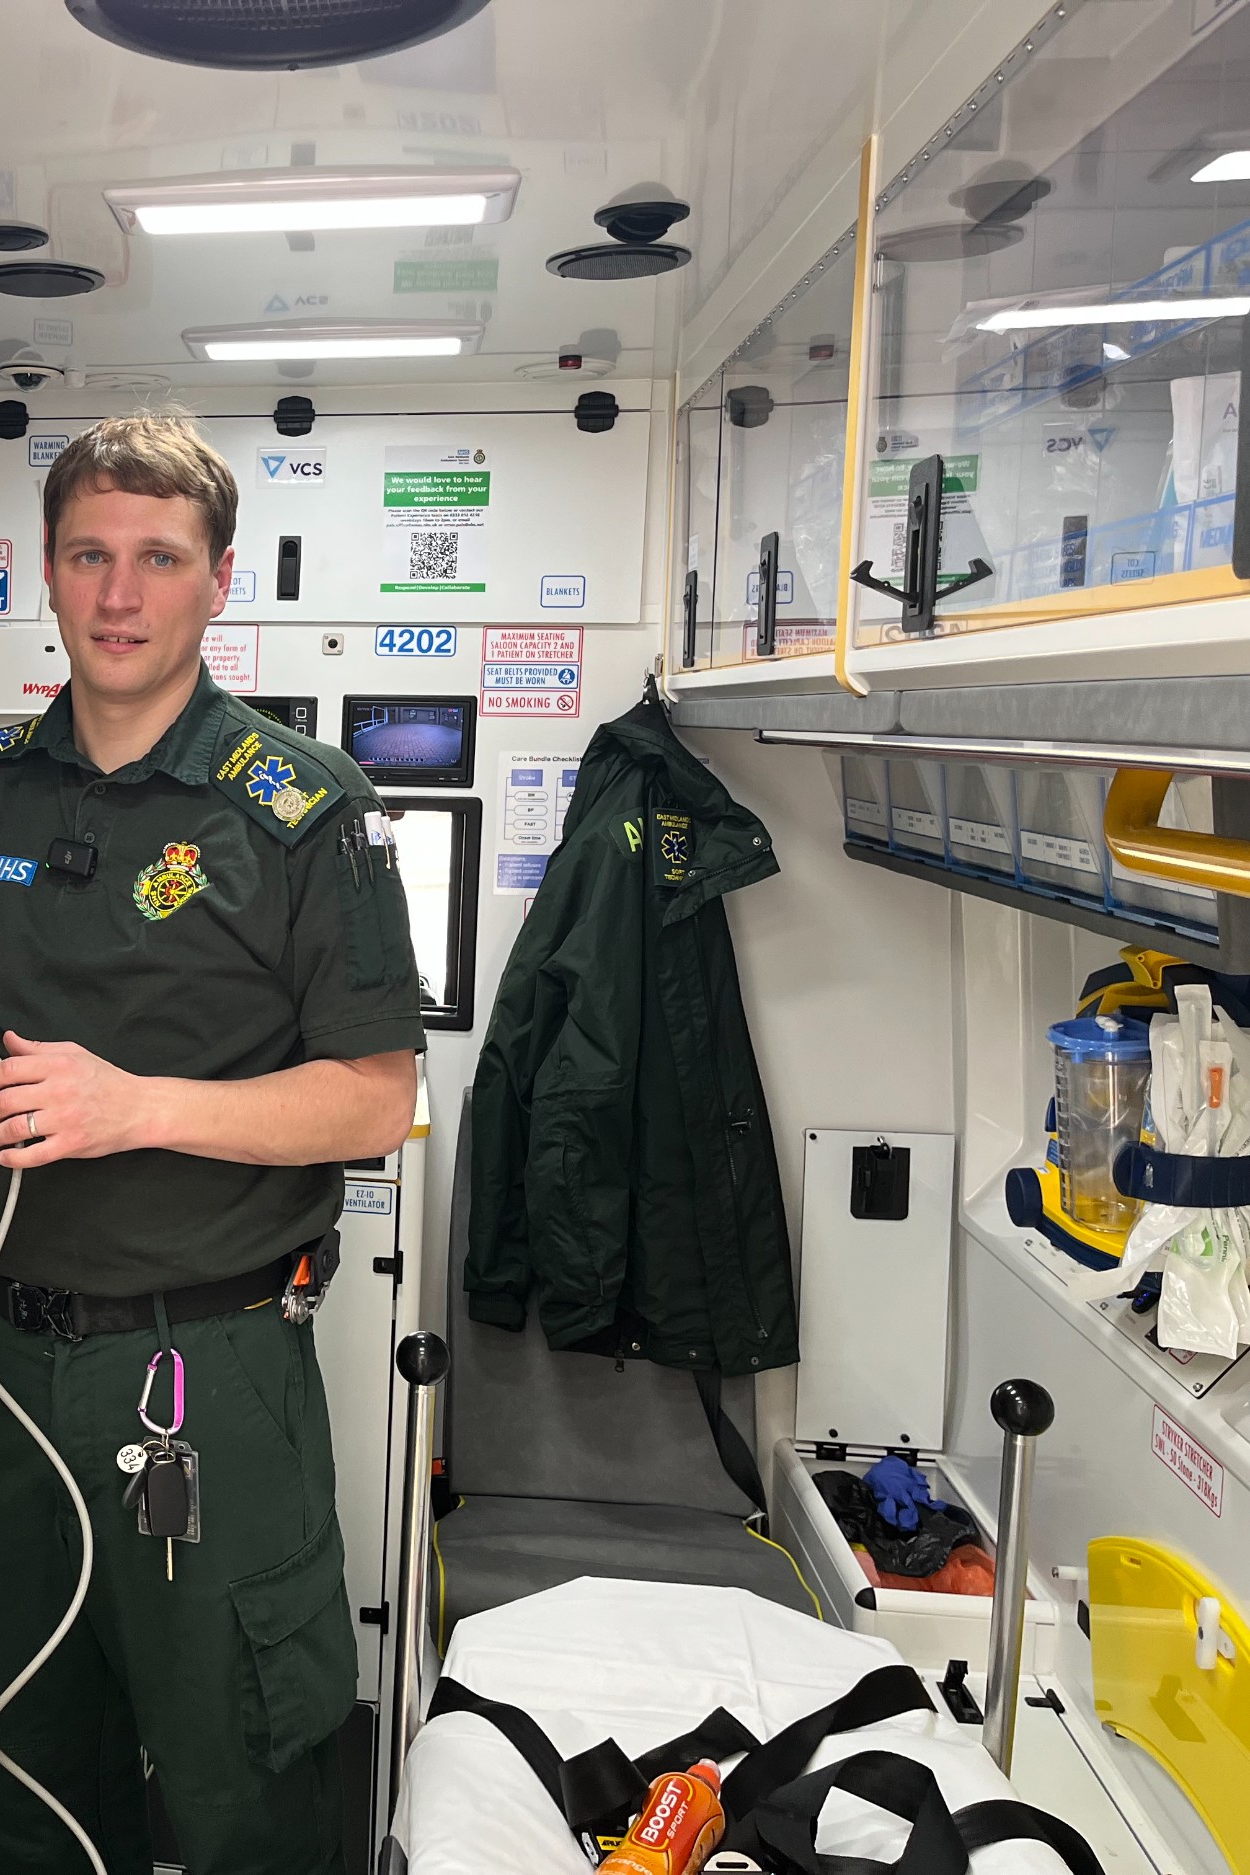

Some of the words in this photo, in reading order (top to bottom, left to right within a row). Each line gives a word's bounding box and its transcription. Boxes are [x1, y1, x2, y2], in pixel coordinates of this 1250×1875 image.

[33, 441, 65, 450] WARMING
[289, 462, 323, 476] VCS
[406, 476, 431, 484] would
[433, 476, 451, 484] love
[386, 486, 405, 494] your
[407, 485, 444, 493] feedback
[446, 485, 466, 493] from
[468, 486, 487, 494] your
[413, 495, 459, 503] experience
[546, 587, 580, 596] BLANKETS
[212, 634, 223, 642] will
[379, 629, 453, 654] 4202
[501, 632, 535, 641] MAXIMUM
[537, 632, 565, 641] SEATING
[223, 644, 238, 652] form
[239, 644, 247, 652] of
[491, 641, 518, 650] SALOON
[519, 641, 551, 650] CAPACITY
[553, 641, 558, 650] 2
[560, 641, 574, 650] AND
[497, 650, 524, 659] PATIENT
[525, 650, 536, 659] ON
[537, 651, 574, 660] STRETCHER
[487, 667, 502, 676] SEAT
[504, 667, 523, 676] BELTS
[524, 668, 558, 676] PROVIDED
[495, 676, 514, 685] MUST
[515, 677, 524, 685] BE
[525, 677, 546, 685] WORN
[488, 697, 502, 708] NO
[505, 697, 551, 708] SMOKING
[216, 761, 233, 781] EAST
[229, 732, 260, 763] MIDLANDS
[228, 741, 263, 781] AMBULANCE
[153, 872, 194, 888] AMBULANCE
[150, 890, 161, 907] NHS
[356, 1190, 374, 1199] EZ-IO
[345, 1199, 385, 1209] VENTILATOR
[1162, 1420, 1184, 1453] STRYKER
[1184, 1442, 1213, 1482] STRETCHER
[120, 1448, 142, 1472] 334
[1155, 1433, 1165, 1456] SWL
[1178, 1455, 1193, 1482] Stone
[640, 1780, 683, 1844] BOOST
[665, 1800, 690, 1841] SPORT
